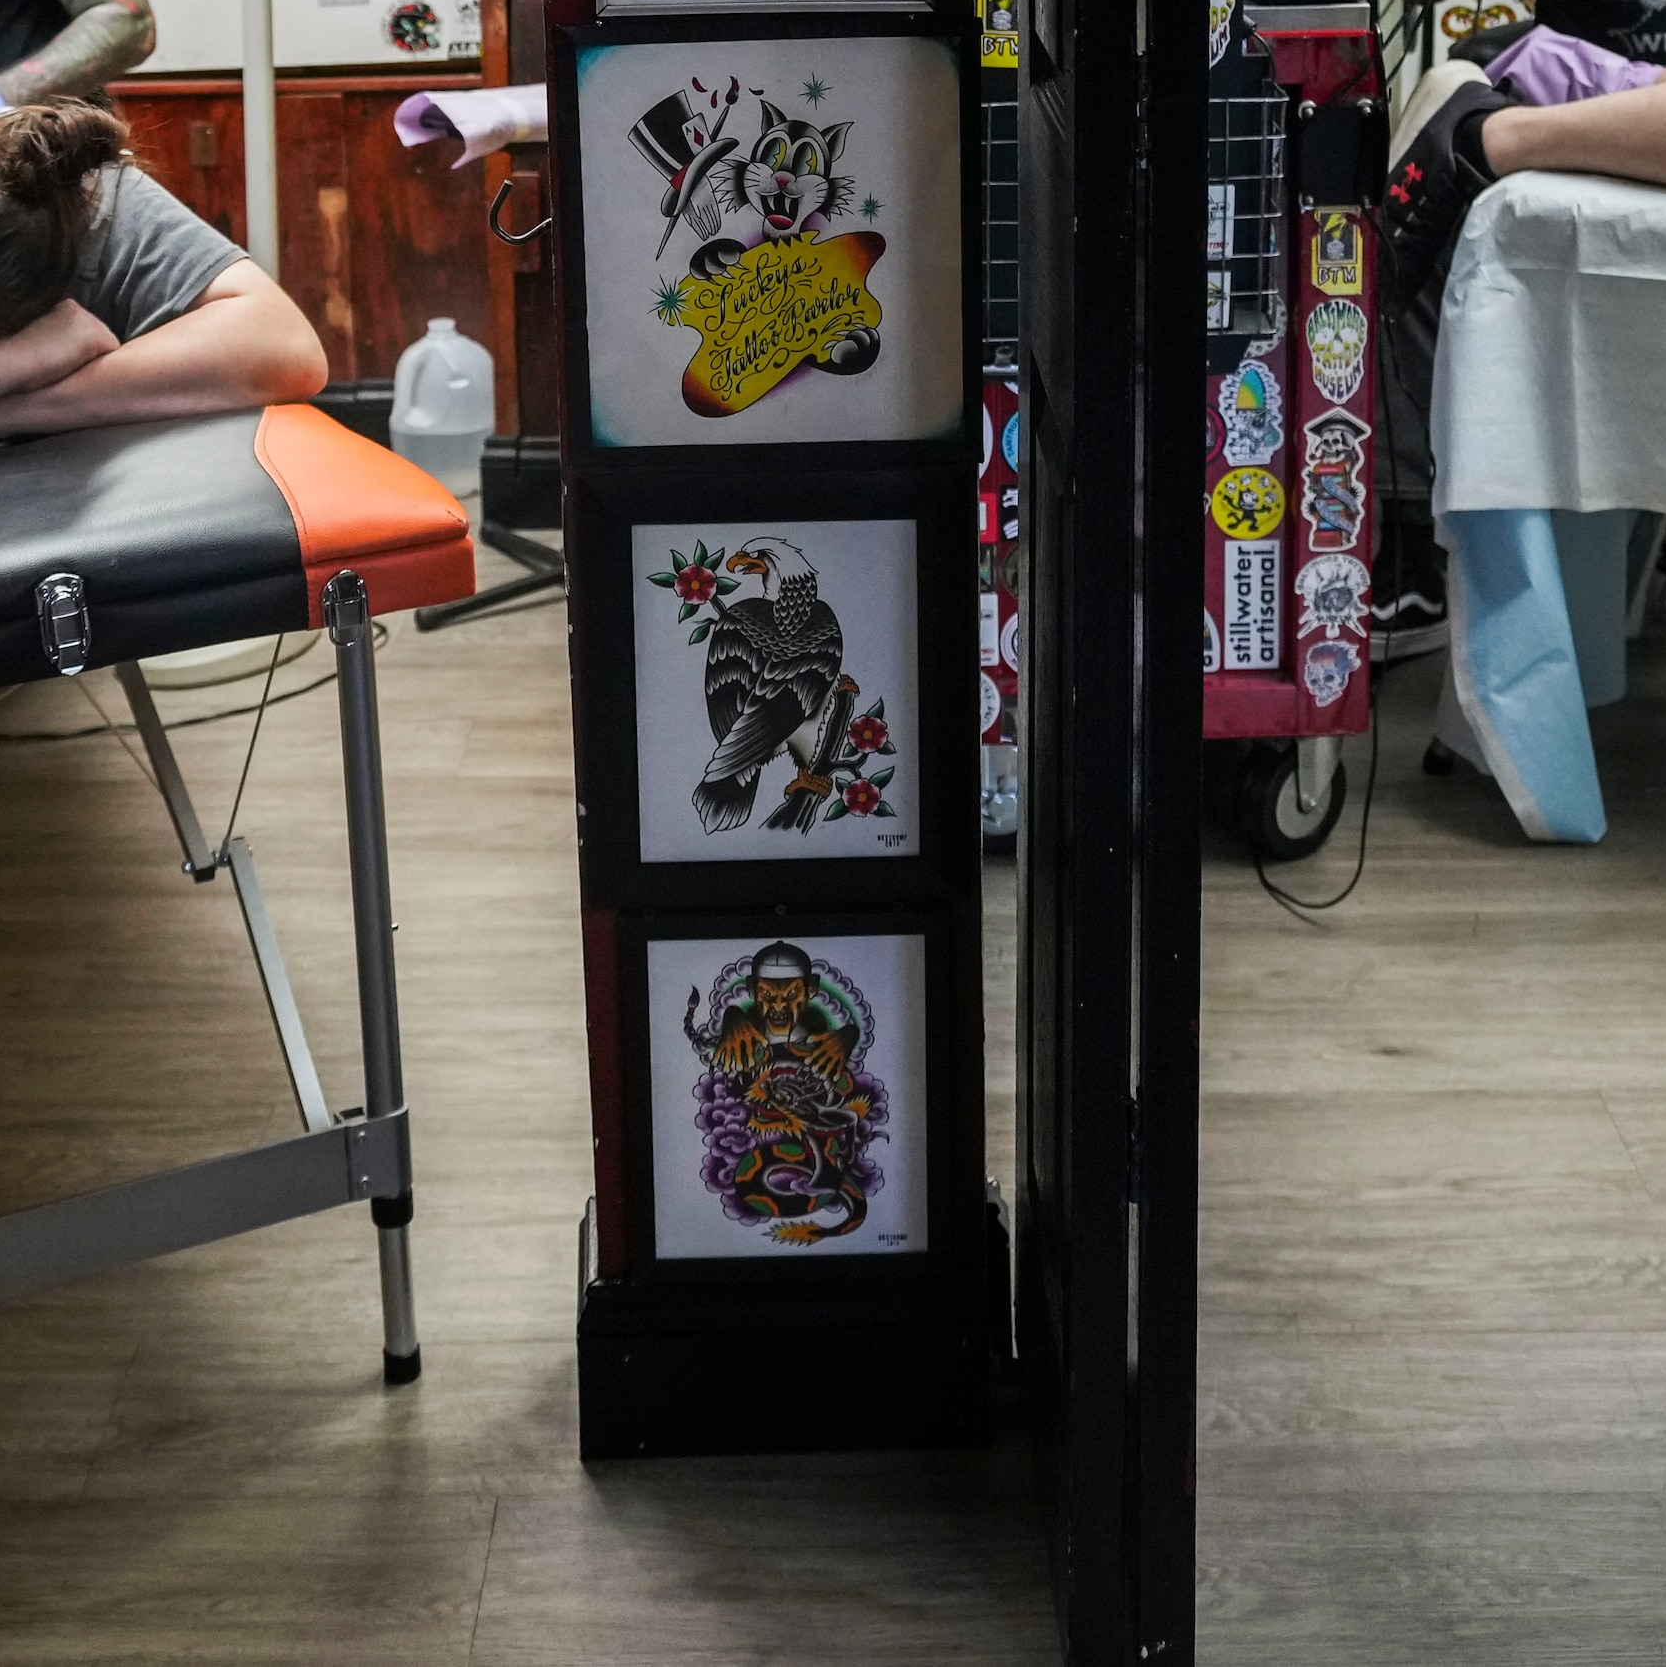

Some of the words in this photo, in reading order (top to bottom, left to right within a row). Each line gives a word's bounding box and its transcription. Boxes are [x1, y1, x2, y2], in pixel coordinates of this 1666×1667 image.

[696, 253, 808, 332] Luckys
[1317, 266, 1357, 285] BTM
[710, 322, 783, 391] Tattoo
[783, 278, 861, 342] Parlor
[1233, 545, 1252, 664] stillwater
